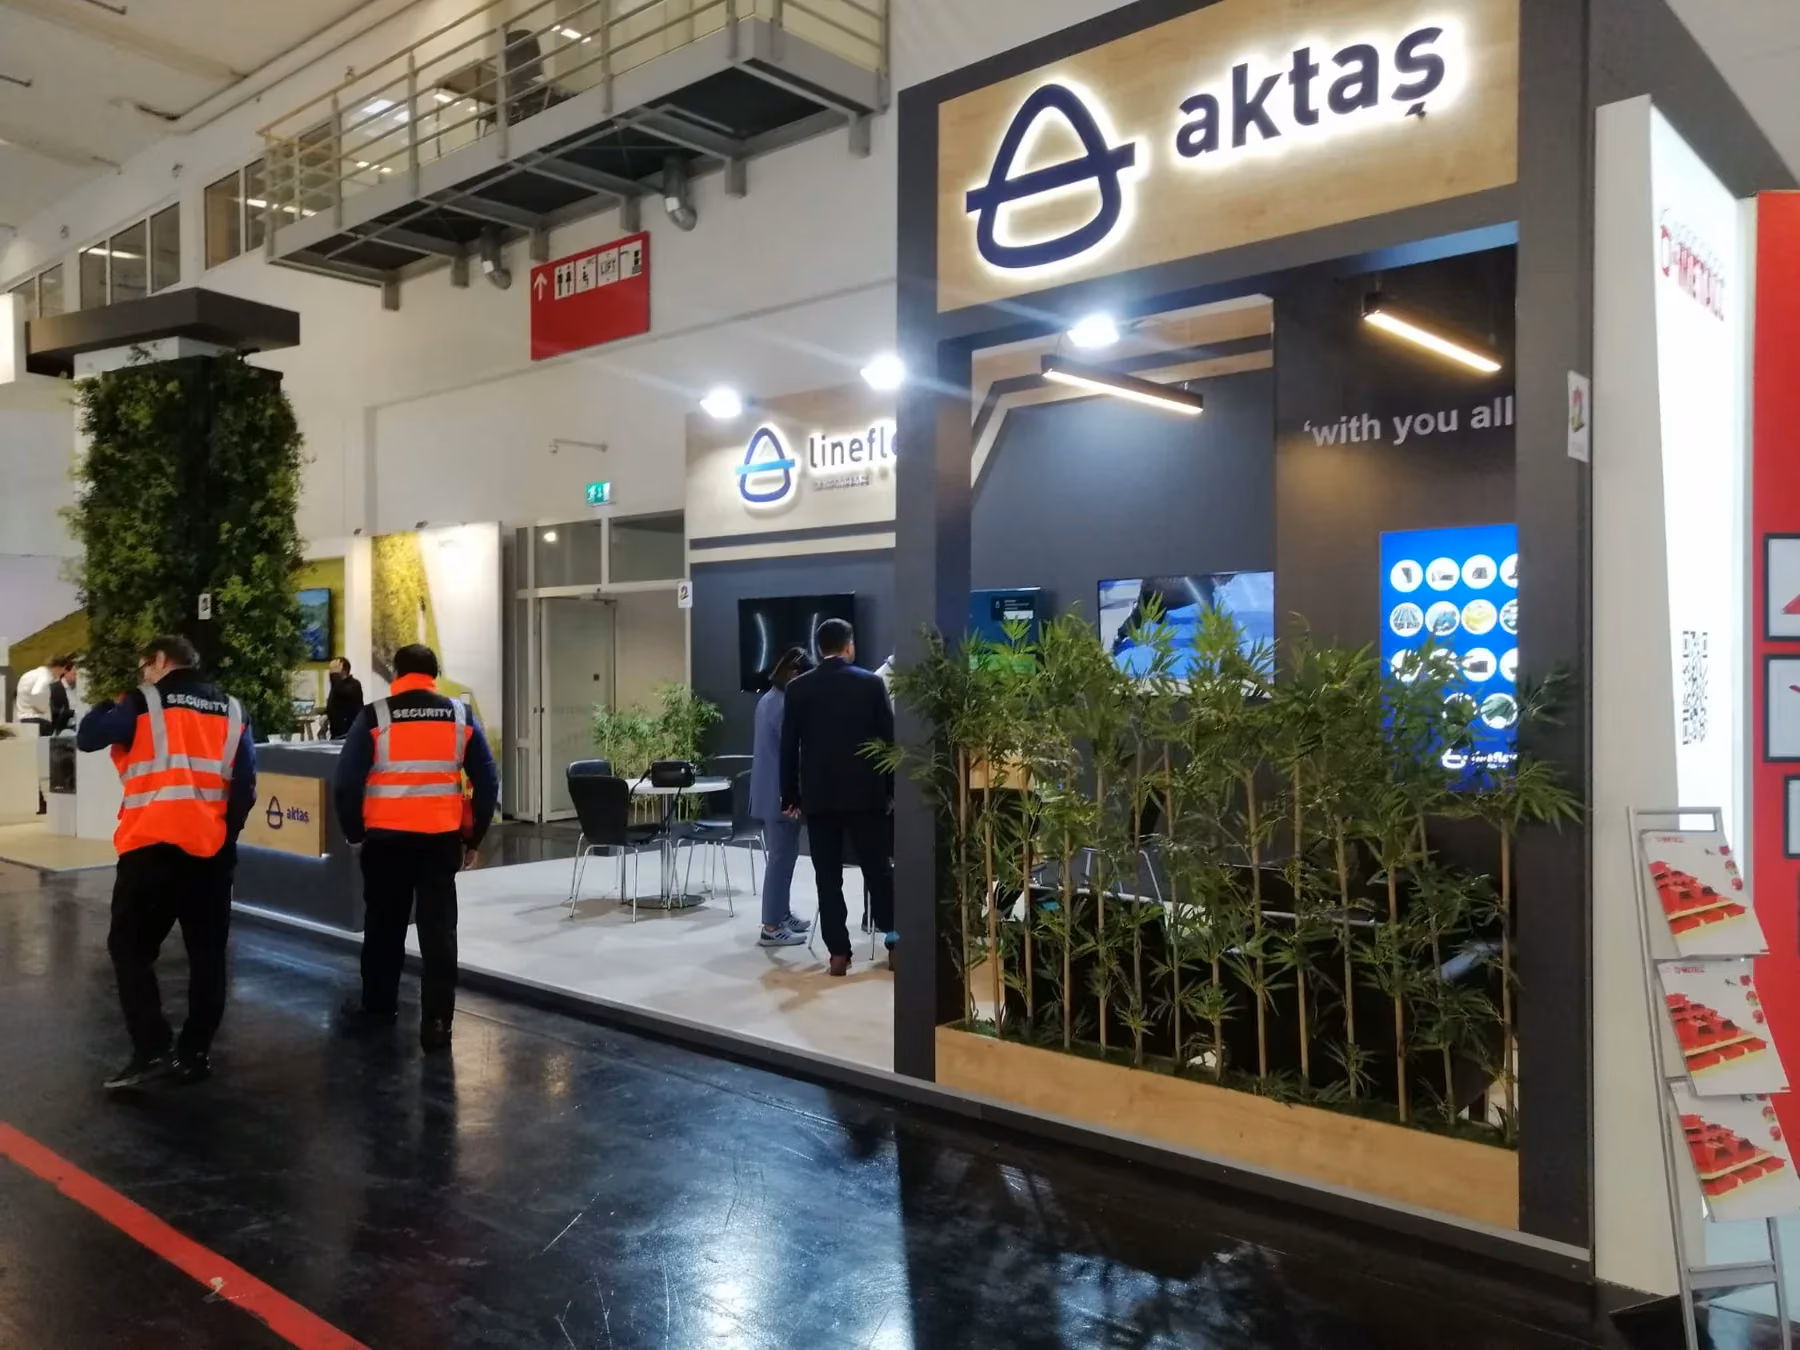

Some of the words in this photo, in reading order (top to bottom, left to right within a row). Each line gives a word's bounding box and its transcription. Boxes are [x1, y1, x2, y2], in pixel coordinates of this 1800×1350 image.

[1175, 26, 1446, 159] aktaş
[1392, 407, 1458, 446] you
[1470, 395, 1514, 429] all
[166, 693, 229, 713] SECURITY
[392, 707, 453, 719] SECURITY
